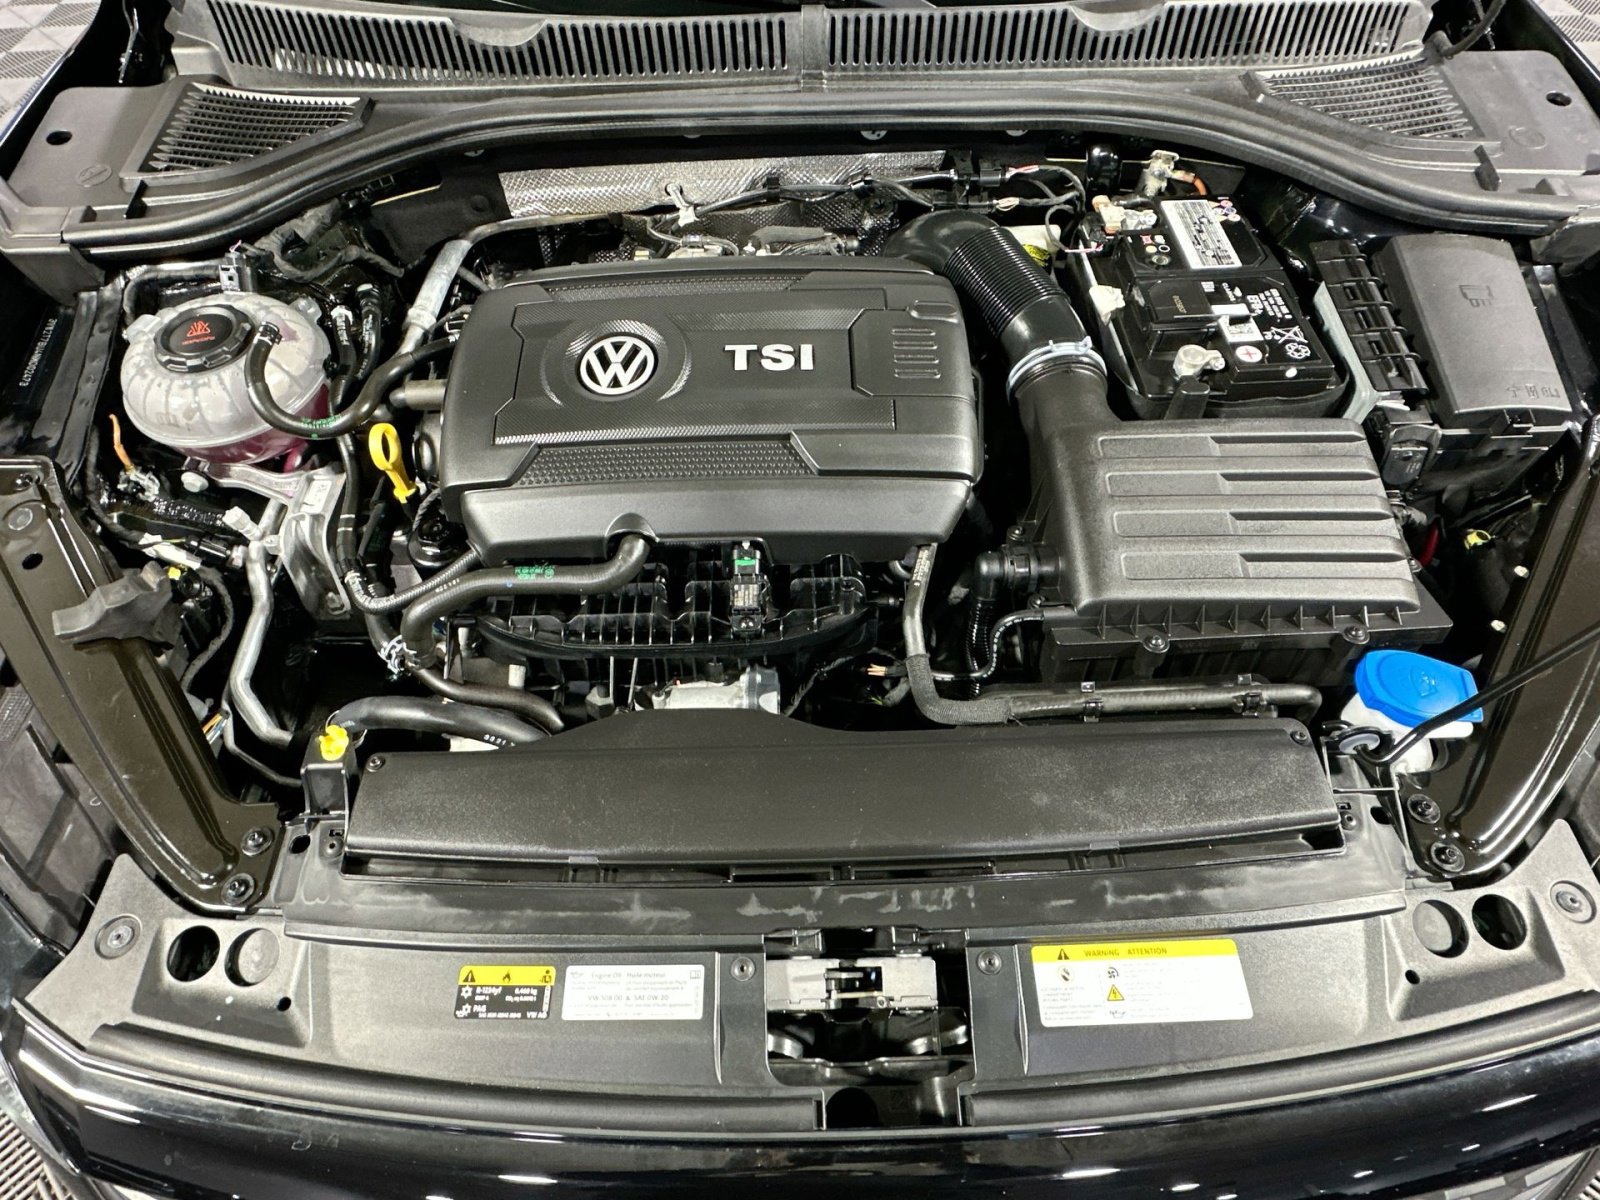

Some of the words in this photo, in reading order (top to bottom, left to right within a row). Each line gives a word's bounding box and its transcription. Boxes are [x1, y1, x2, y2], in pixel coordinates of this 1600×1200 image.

[580, 336, 655, 395] VW
[724, 344, 814, 371] TSI
[1083, 949, 1120, 957] WARNING
[1127, 947, 1168, 955] ATTENTION
[591, 971, 611, 980] Engine
